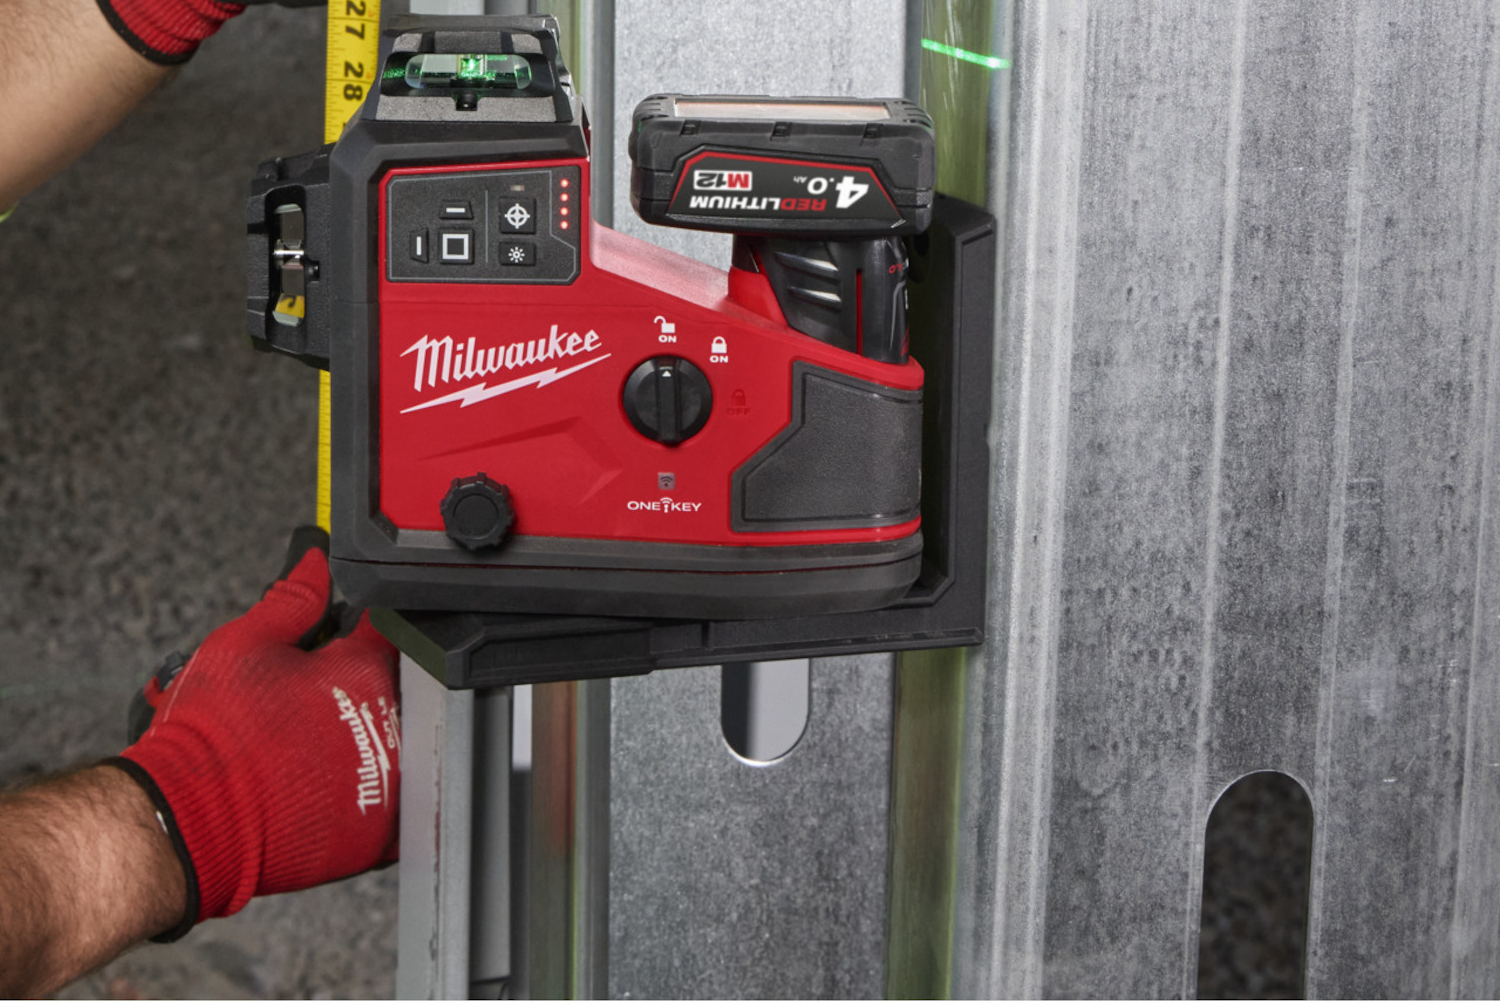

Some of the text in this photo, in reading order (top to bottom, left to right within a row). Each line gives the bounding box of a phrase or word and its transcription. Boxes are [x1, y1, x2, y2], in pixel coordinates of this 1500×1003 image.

[345, 0, 366, 40] 27
[343, 61, 364, 102] 28
[696, 172, 750, 189] M12
[807, 175, 870, 210] 4.0
[689, 194, 829, 212] REDLITHIUM
[658, 334, 678, 344] ON
[400, 323, 603, 393] Milwaukee
[709, 355, 730, 364] ON
[332, 686, 382, 816] Milwaukee
